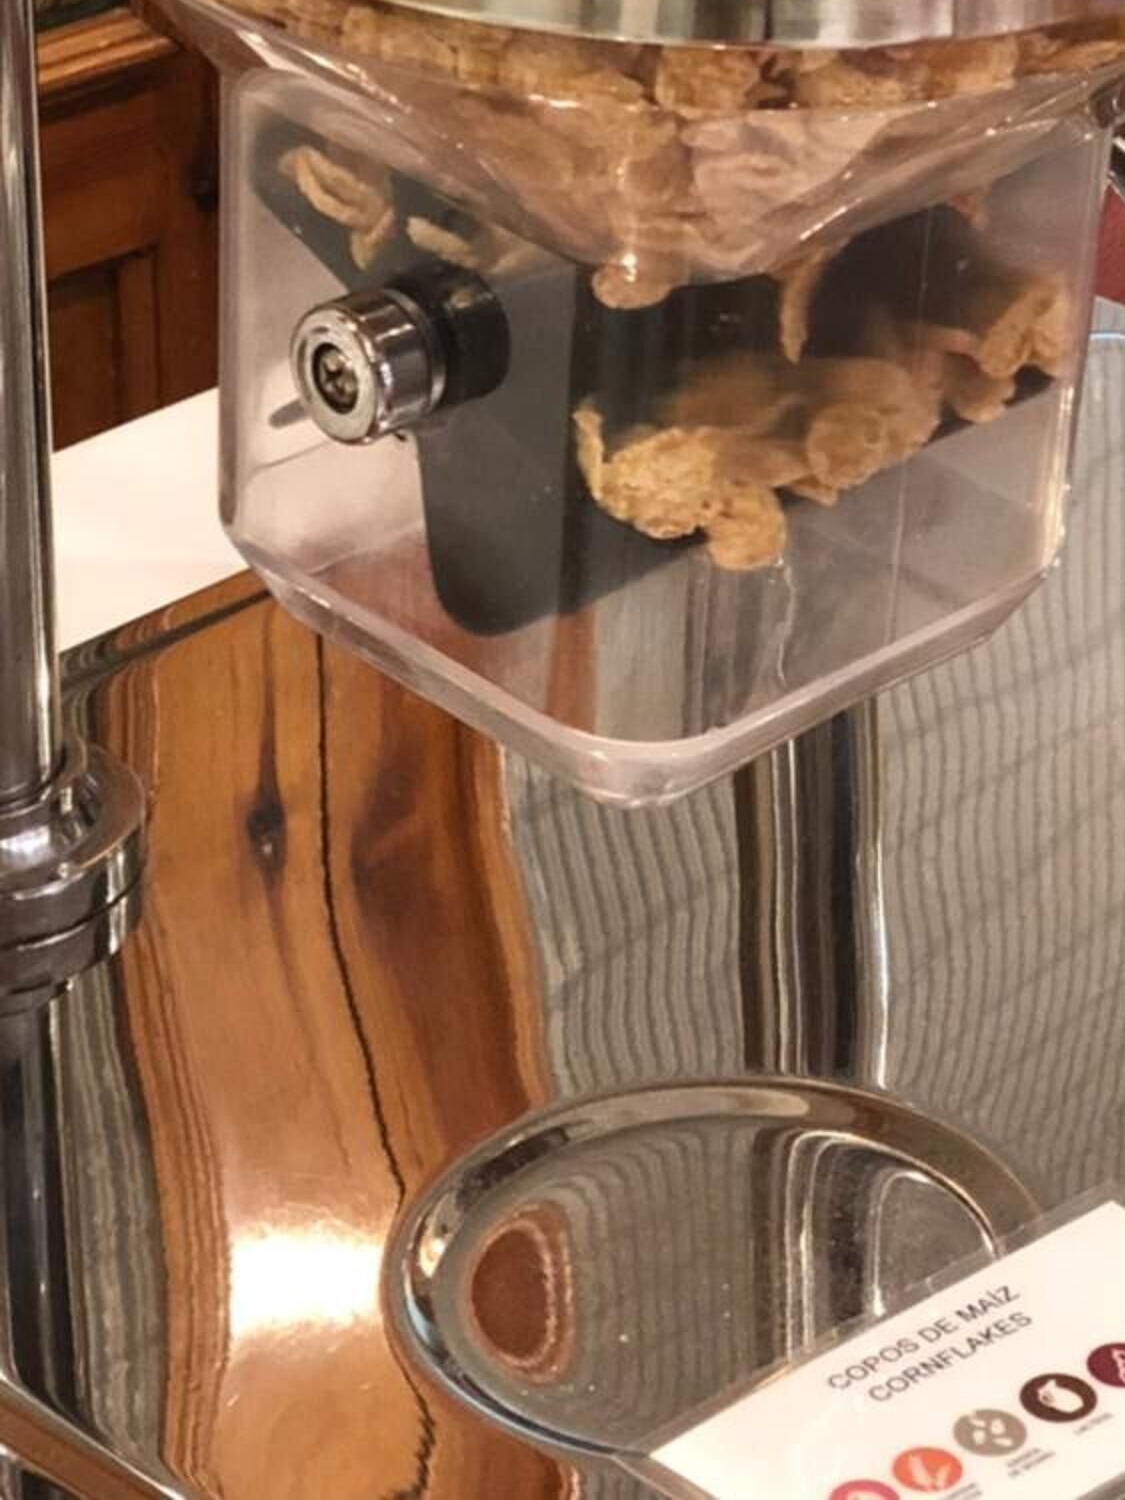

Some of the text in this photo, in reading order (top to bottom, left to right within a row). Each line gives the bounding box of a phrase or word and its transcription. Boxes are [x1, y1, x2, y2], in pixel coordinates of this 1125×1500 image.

[828, 1337, 919, 1389] COPOS
[917, 1317, 959, 1343] DE
[868, 1311, 1033, 1402] CORNFLAKES
